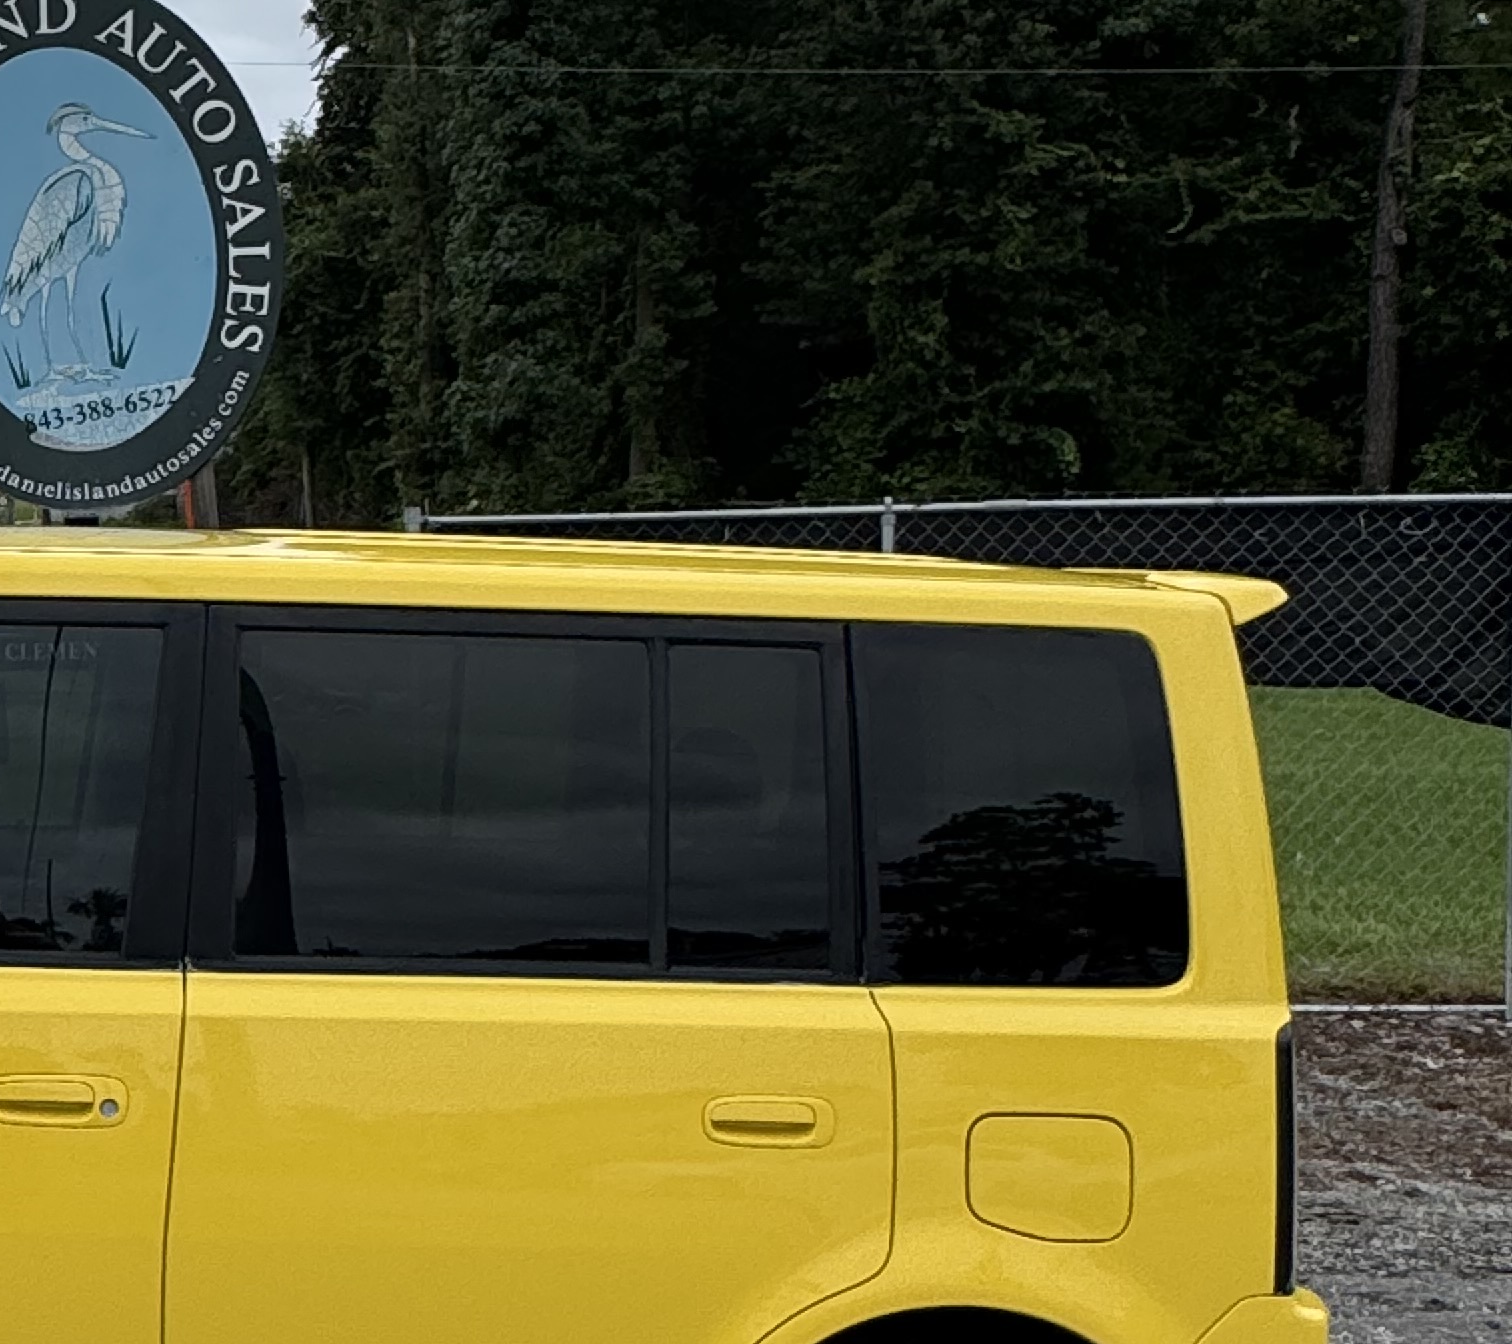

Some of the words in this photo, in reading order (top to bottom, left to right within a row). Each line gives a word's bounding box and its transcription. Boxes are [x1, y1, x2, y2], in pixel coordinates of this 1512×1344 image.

[94, 9, 236, 143] AUTO
[213, 158, 272, 353] SALES
[25, 385, 176, 433] 843-388-6522
